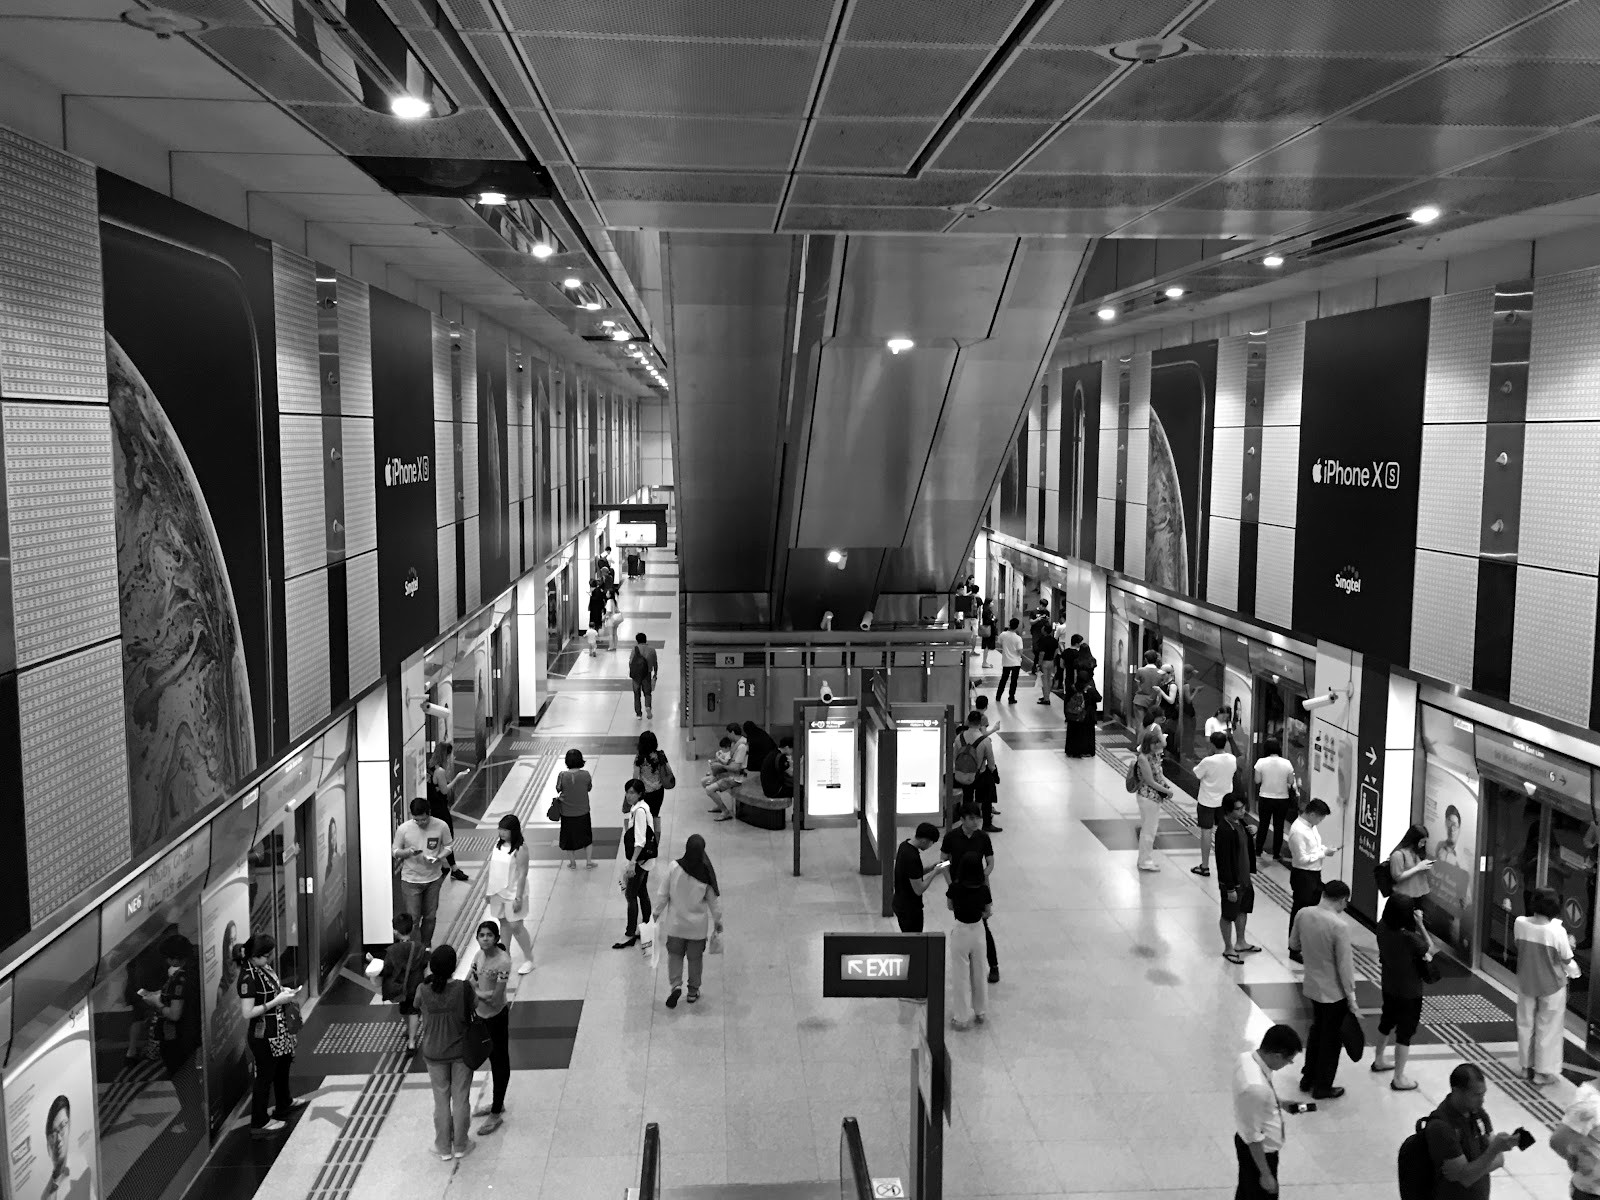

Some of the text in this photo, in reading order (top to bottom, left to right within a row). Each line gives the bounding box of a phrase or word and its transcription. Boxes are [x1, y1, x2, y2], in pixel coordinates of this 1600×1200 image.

[391, 456, 417, 486] iPhone
[1323, 459, 1370, 487] iPhone
[1335, 573, 1361, 594] Singtel
[1549, 771, 1555, 782] 6
[127, 895, 142, 916] NE6
[866, 958, 903, 977] EXIT
